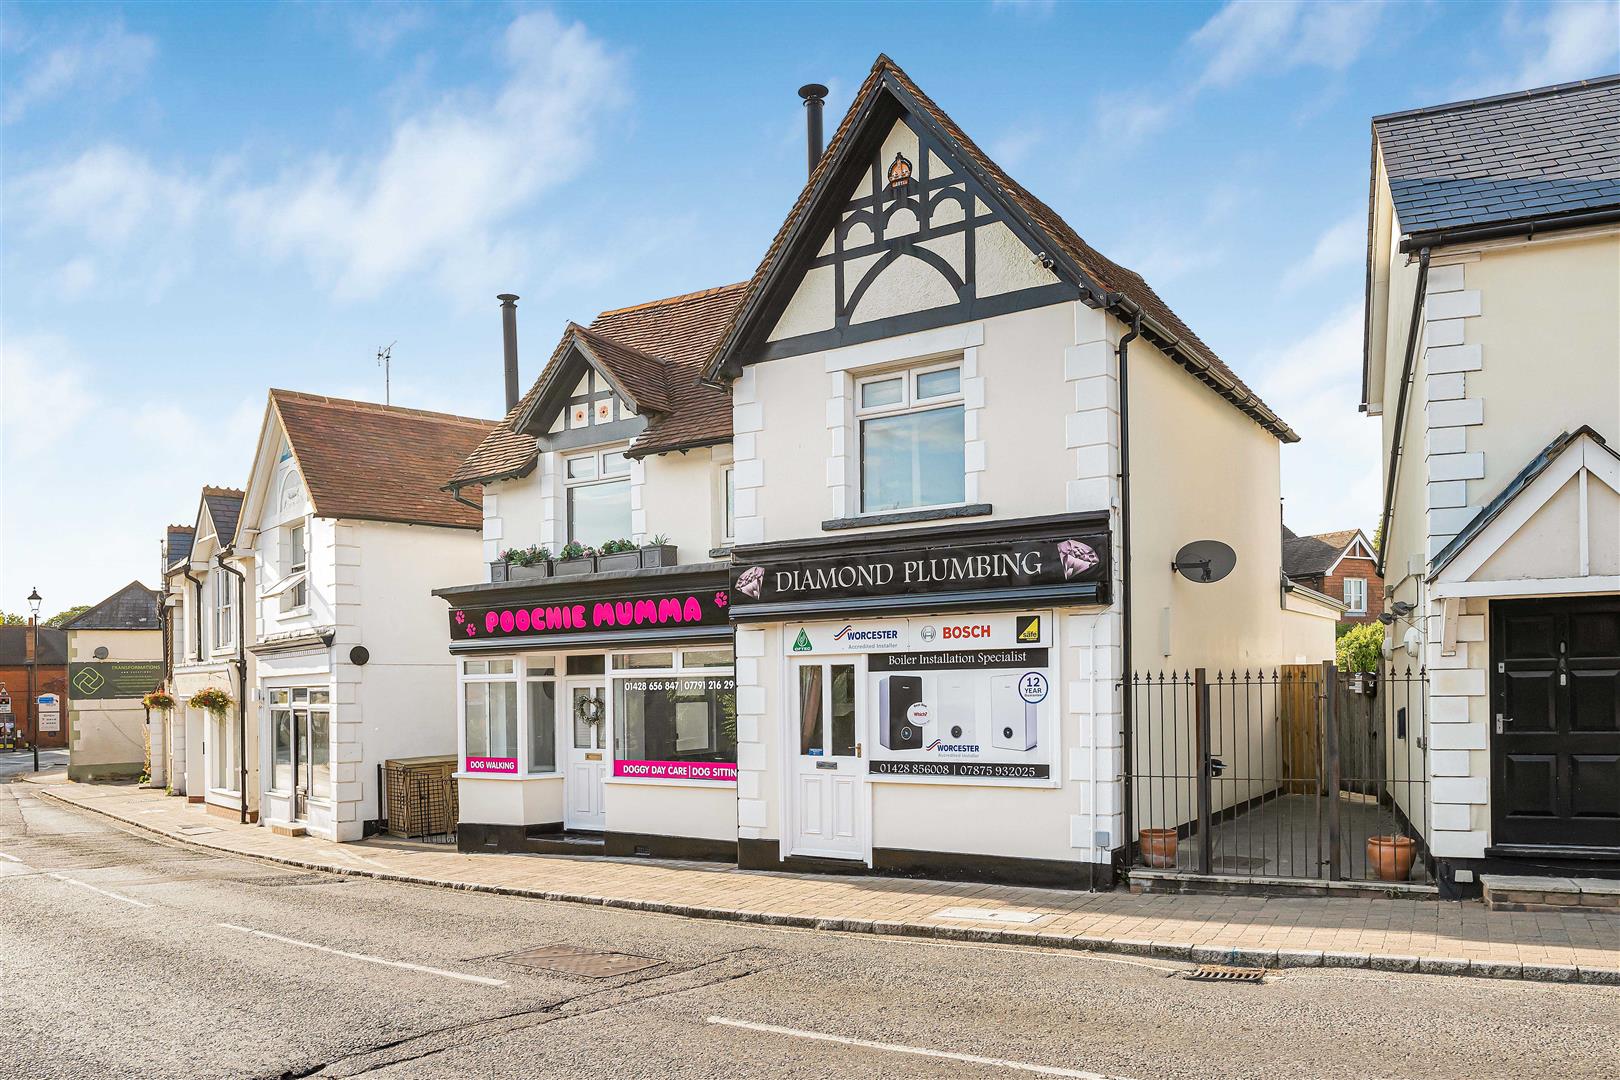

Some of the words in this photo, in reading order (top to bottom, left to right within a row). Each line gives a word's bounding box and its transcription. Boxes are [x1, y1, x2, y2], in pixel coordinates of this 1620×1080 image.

[775, 563, 894, 593] DIAMOND
[903, 551, 1043, 583] PLUMBING
[485, 604, 587, 633] POOCHIE
[592, 596, 702, 626] MUMMA
[847, 630, 898, 640] WORCESTER
[942, 625, 991, 639] BOSCH
[888, 655, 917, 665] Boiler
[919, 653, 975, 665] Installation
[977, 651, 1027, 666] Specialist
[624, 682, 647, 691] 01428
[648, 681, 663, 690] 656
[664, 681, 680, 690] 847
[684, 680, 706, 690] 07791
[708, 680, 722, 690] 216
[1026, 677, 1040, 687] 12
[937, 744, 980, 752] WORCESTER
[470, 760, 485, 769] DOG
[486, 761, 515, 770] WALKING
[623, 765, 650, 774] DOGGY
[651, 765, 667, 774] DAY
[668, 765, 687, 775] CARE
[692, 767, 711, 777] DOG
[879, 763, 910, 774] 01428
[912, 764, 949, 775] 856008
[959, 765, 993, 776] 07875
[995, 766, 1036, 778] 932025
